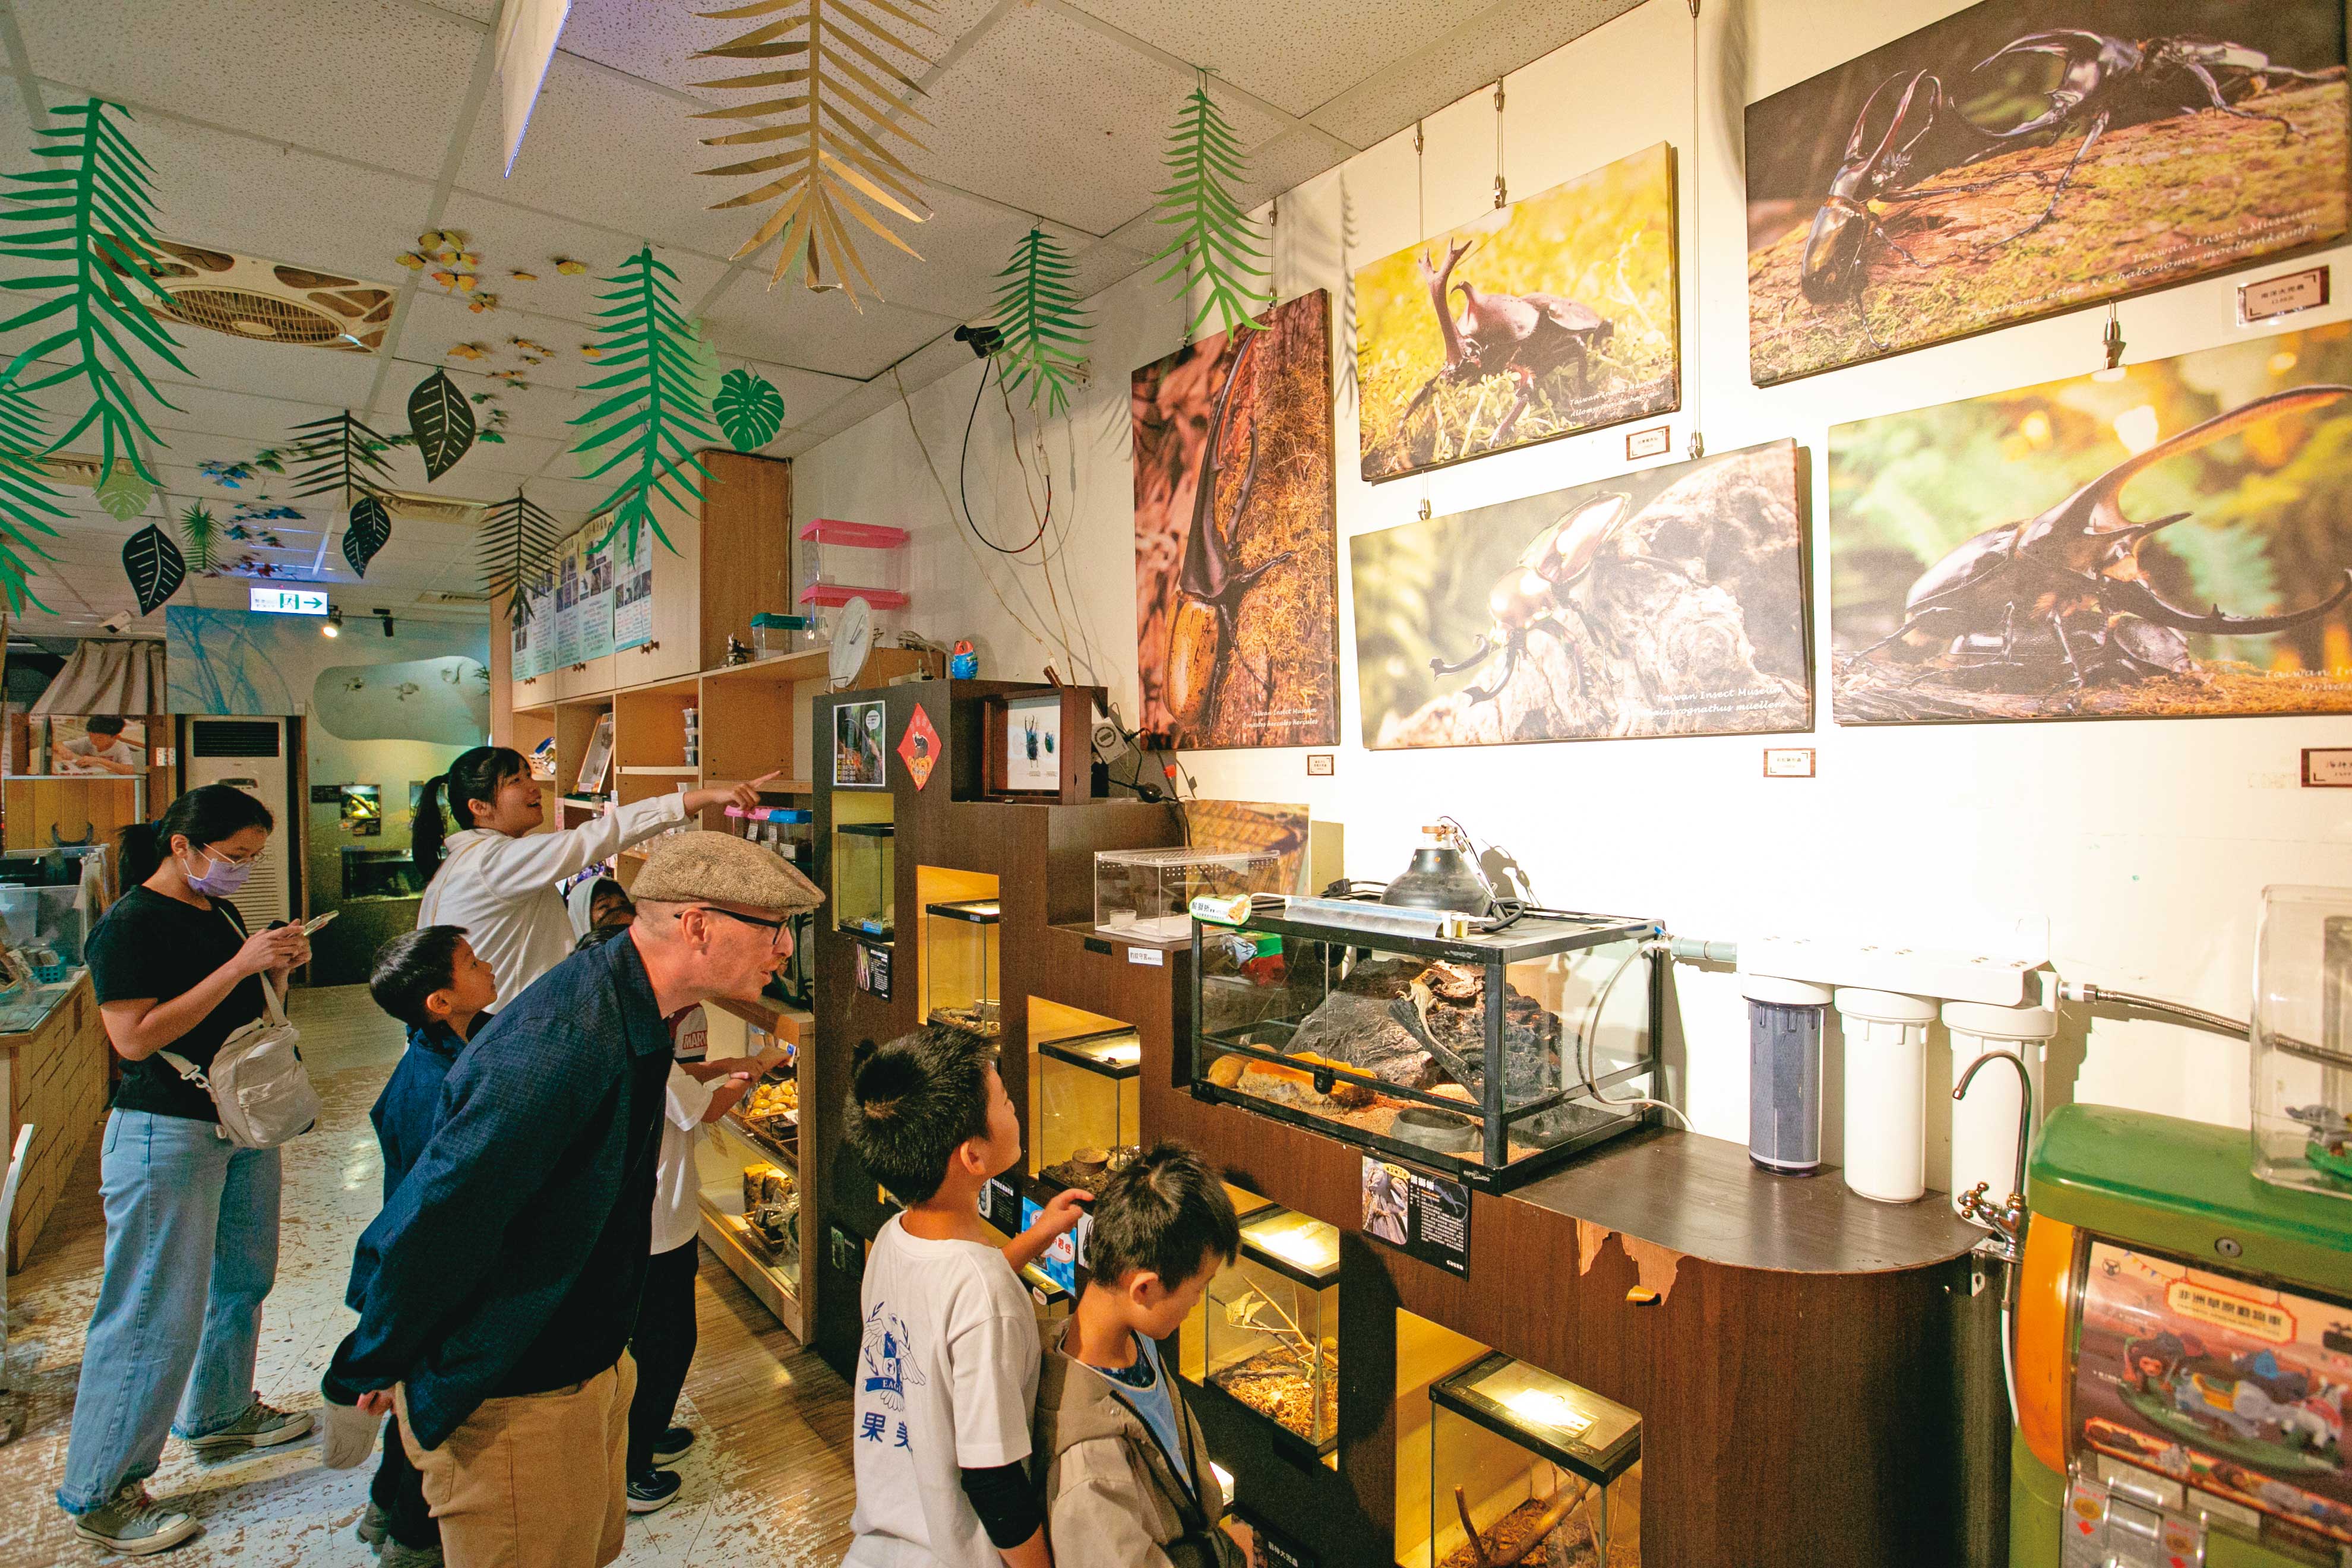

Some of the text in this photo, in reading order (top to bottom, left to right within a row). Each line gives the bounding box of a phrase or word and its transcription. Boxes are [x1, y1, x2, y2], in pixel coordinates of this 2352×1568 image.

[2132, 207, 2318, 263] Taiwan Insect Museum
[1967, 295, 2044, 321] Chalcosoma
[2047, 284, 2083, 300] atlas
[2108, 254, 2198, 284] Chalcosoma
[2264, 668, 2330, 679] Taiwan
[1656, 684, 1787, 702] Taiwan Insect Museum
